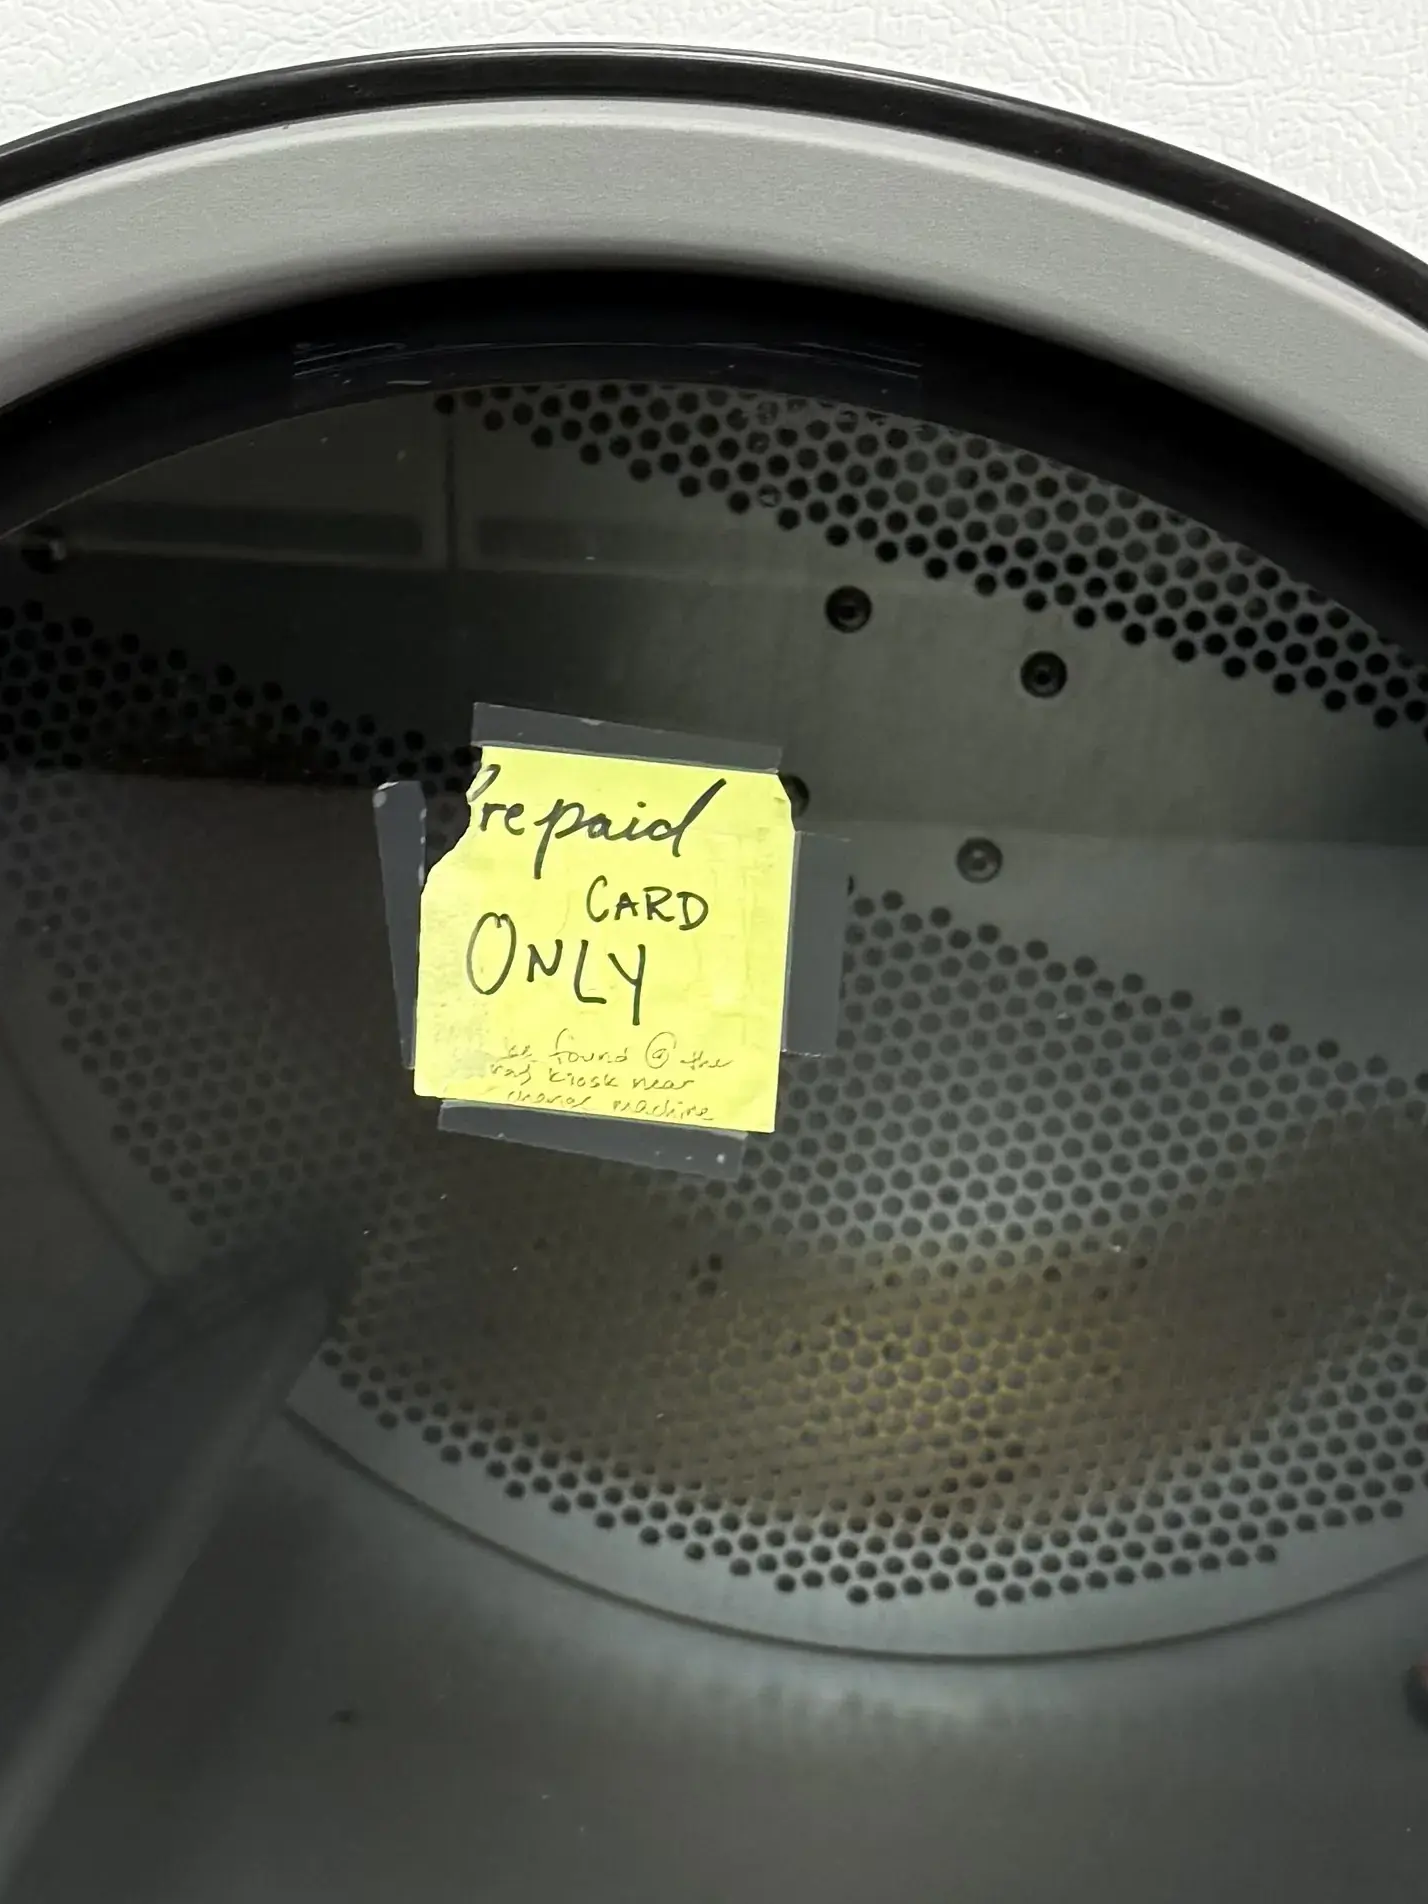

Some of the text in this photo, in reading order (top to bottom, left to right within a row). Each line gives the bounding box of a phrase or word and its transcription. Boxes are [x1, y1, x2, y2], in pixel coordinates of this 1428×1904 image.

[585, 875, 710, 931] CARD
[466, 912, 647, 1026] ONLY
[549, 1028, 628, 1065] found
[645, 1031, 677, 1070] @
[632, 1077, 695, 1091] near
